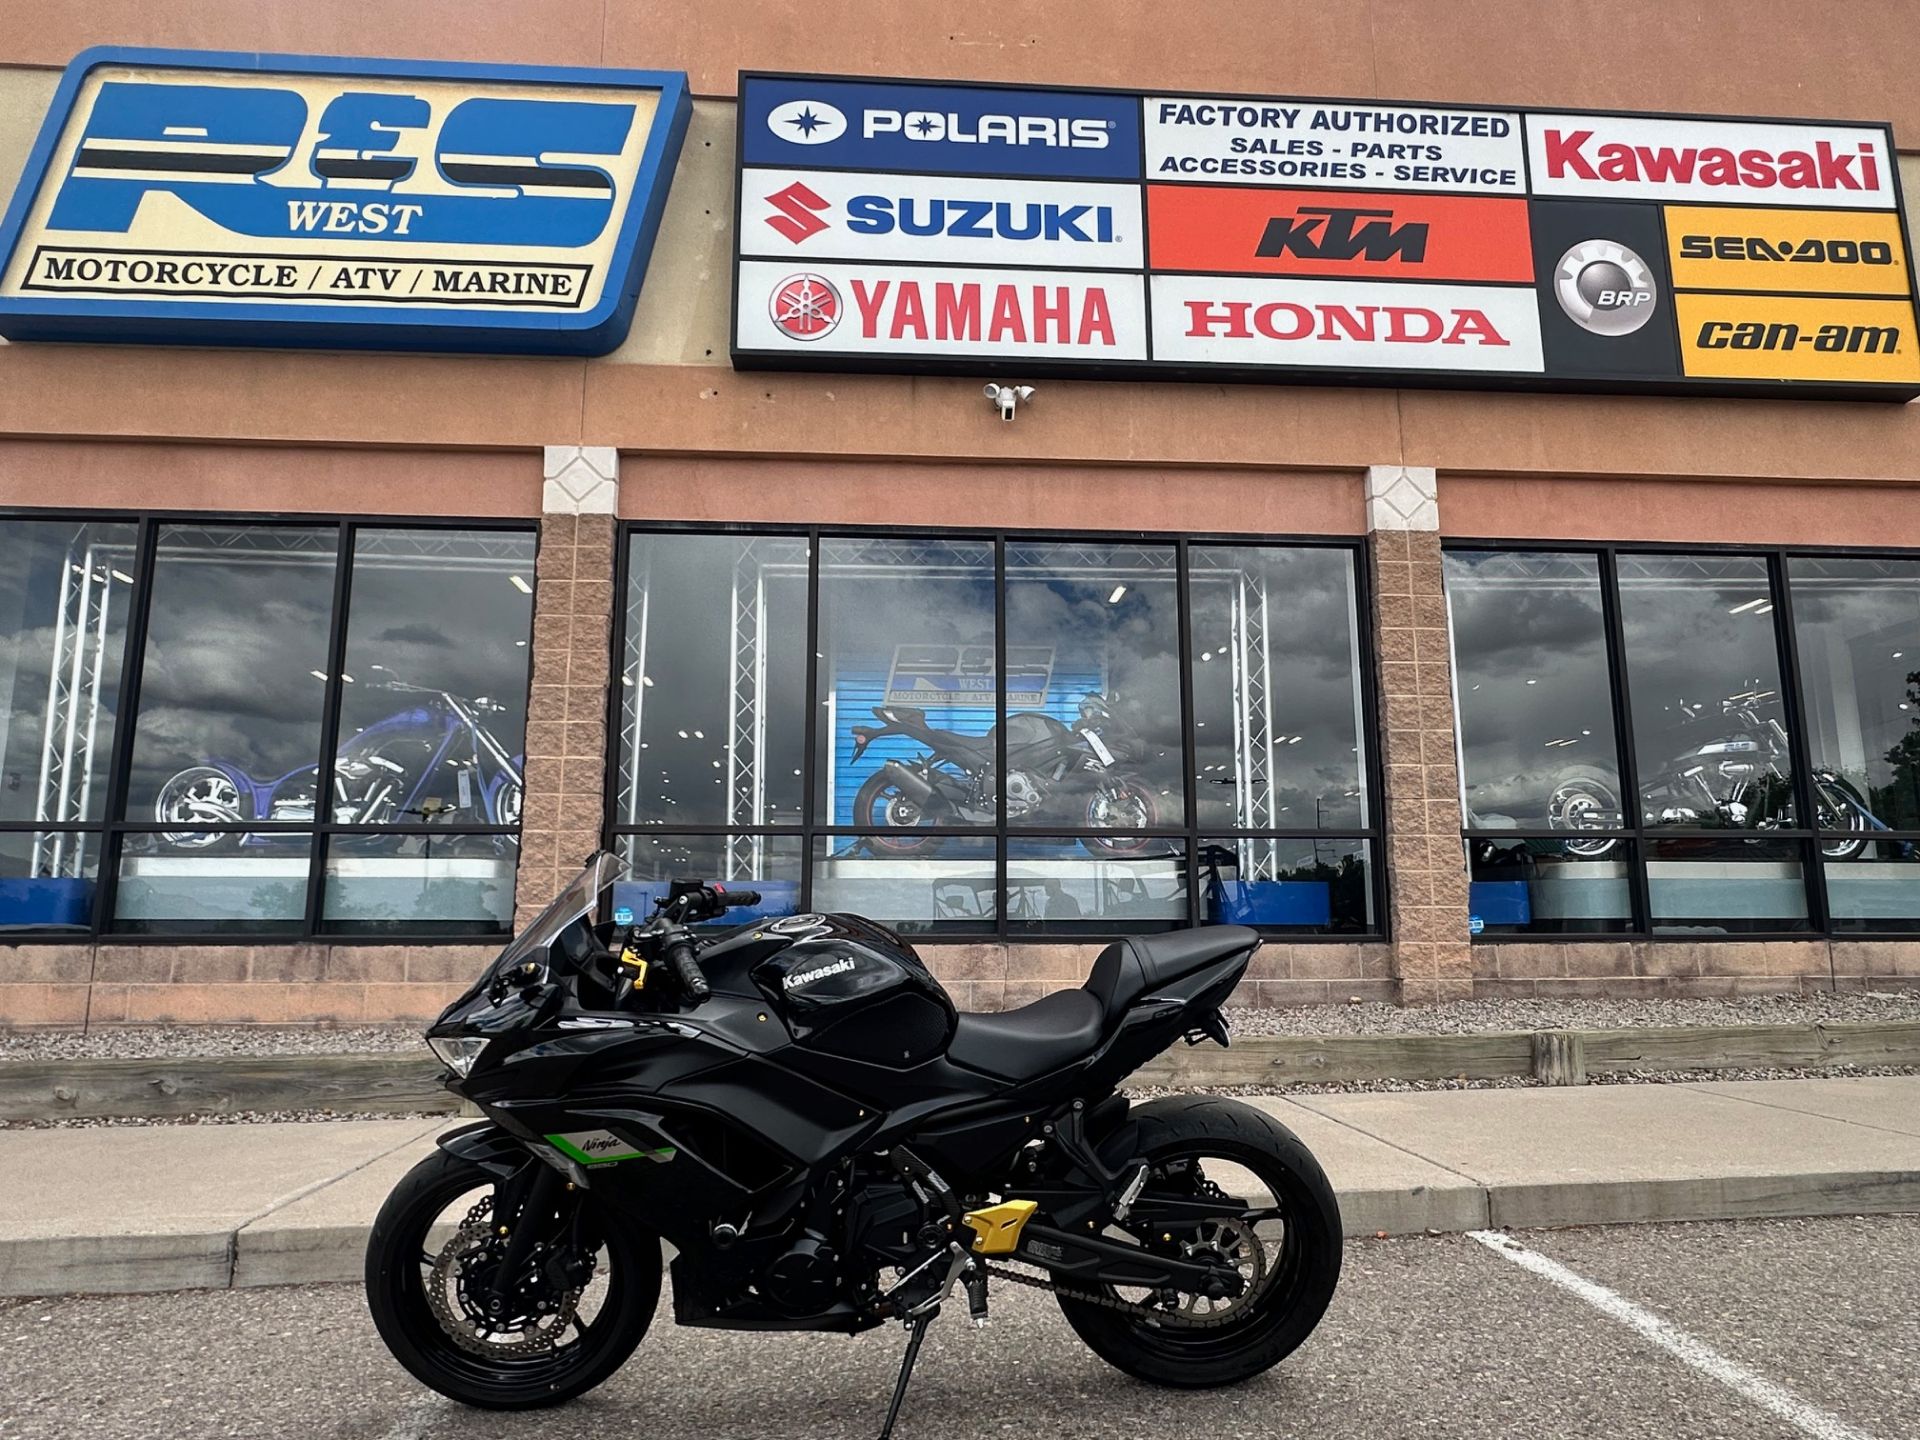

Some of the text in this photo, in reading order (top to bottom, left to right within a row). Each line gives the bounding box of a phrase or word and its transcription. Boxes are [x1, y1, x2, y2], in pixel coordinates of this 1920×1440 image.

[863, 108, 1110, 150] POLARIS
[1158, 103, 1511, 138] FACTORY AUTHORIZED
[1230, 137, 1323, 156] SALES
[1350, 142, 1443, 161] PARTS
[1543, 129, 1881, 191] Kawasaki
[1158, 156, 1367, 180] ACCESSORIES
[1393, 165, 1517, 186] SERVICE
[287, 200, 423, 235] WEST
[846, 195, 1113, 243] SUZUKI
[1254, 206, 1430, 263] KTM
[43, 256, 298, 289] MOTORCYCLE
[330, 266, 402, 291] ATV
[431, 269, 573, 297] MARINE
[850, 278, 1116, 346] YAMAHA
[1597, 289, 1652, 308] BRP
[1183, 300, 1511, 346] HONDA
[1696, 321, 1900, 354] can-am
[958, 678, 993, 690] WEST
[1005, 693, 1038, 702] ARINE
[782, 956, 855, 990] Kawasaki
[581, 1135, 621, 1152] Ninja
